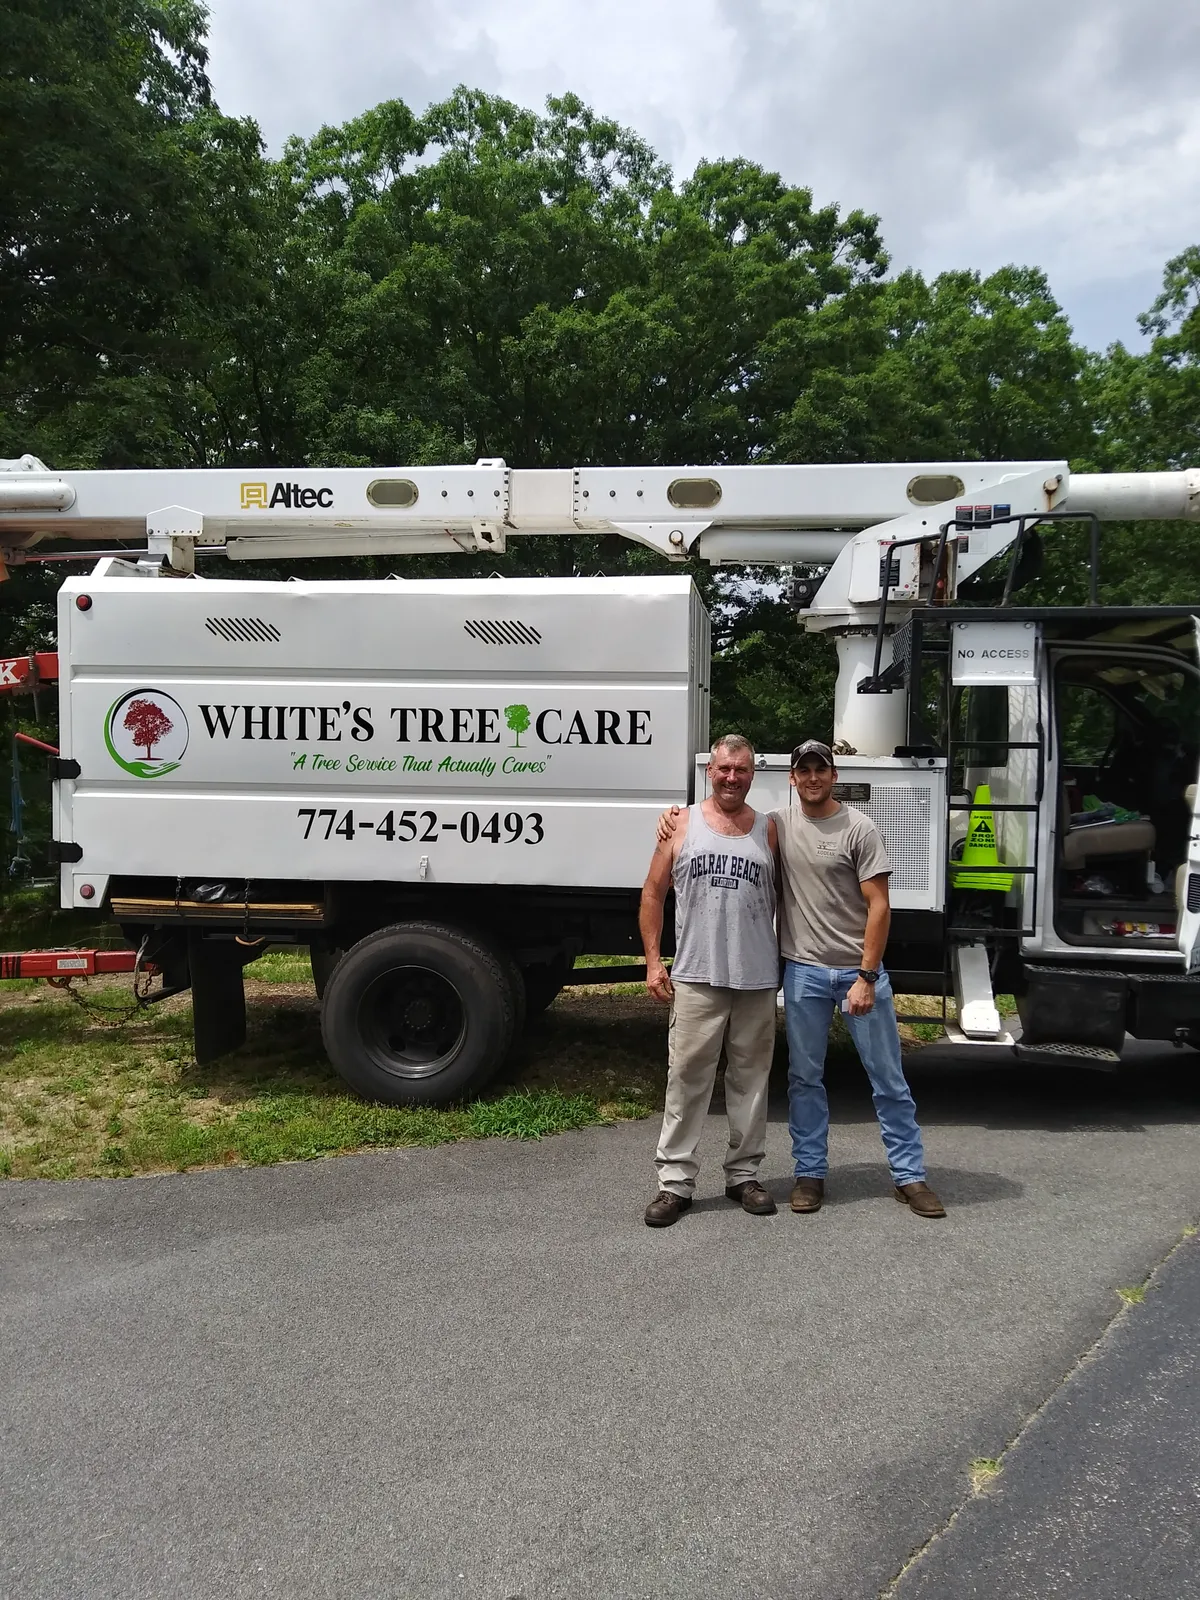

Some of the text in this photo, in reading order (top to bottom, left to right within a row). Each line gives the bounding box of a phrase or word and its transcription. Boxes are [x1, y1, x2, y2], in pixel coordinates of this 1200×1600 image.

[269, 482, 333, 508] Altec
[957, 649, 1029, 659] NO ACCESS
[198, 700, 653, 746] WHITE'S TREE CARE
[312, 753, 342, 771] Tree
[346, 753, 397, 773] Service
[402, 754, 433, 772] That
[437, 755, 497, 778] Actually
[502, 754, 553, 775] Cares"
[297, 808, 545, 845] 774-452-0493
[691, 854, 761, 886] DELRAY BEACH
[713, 877, 736, 888] FLORIDA
